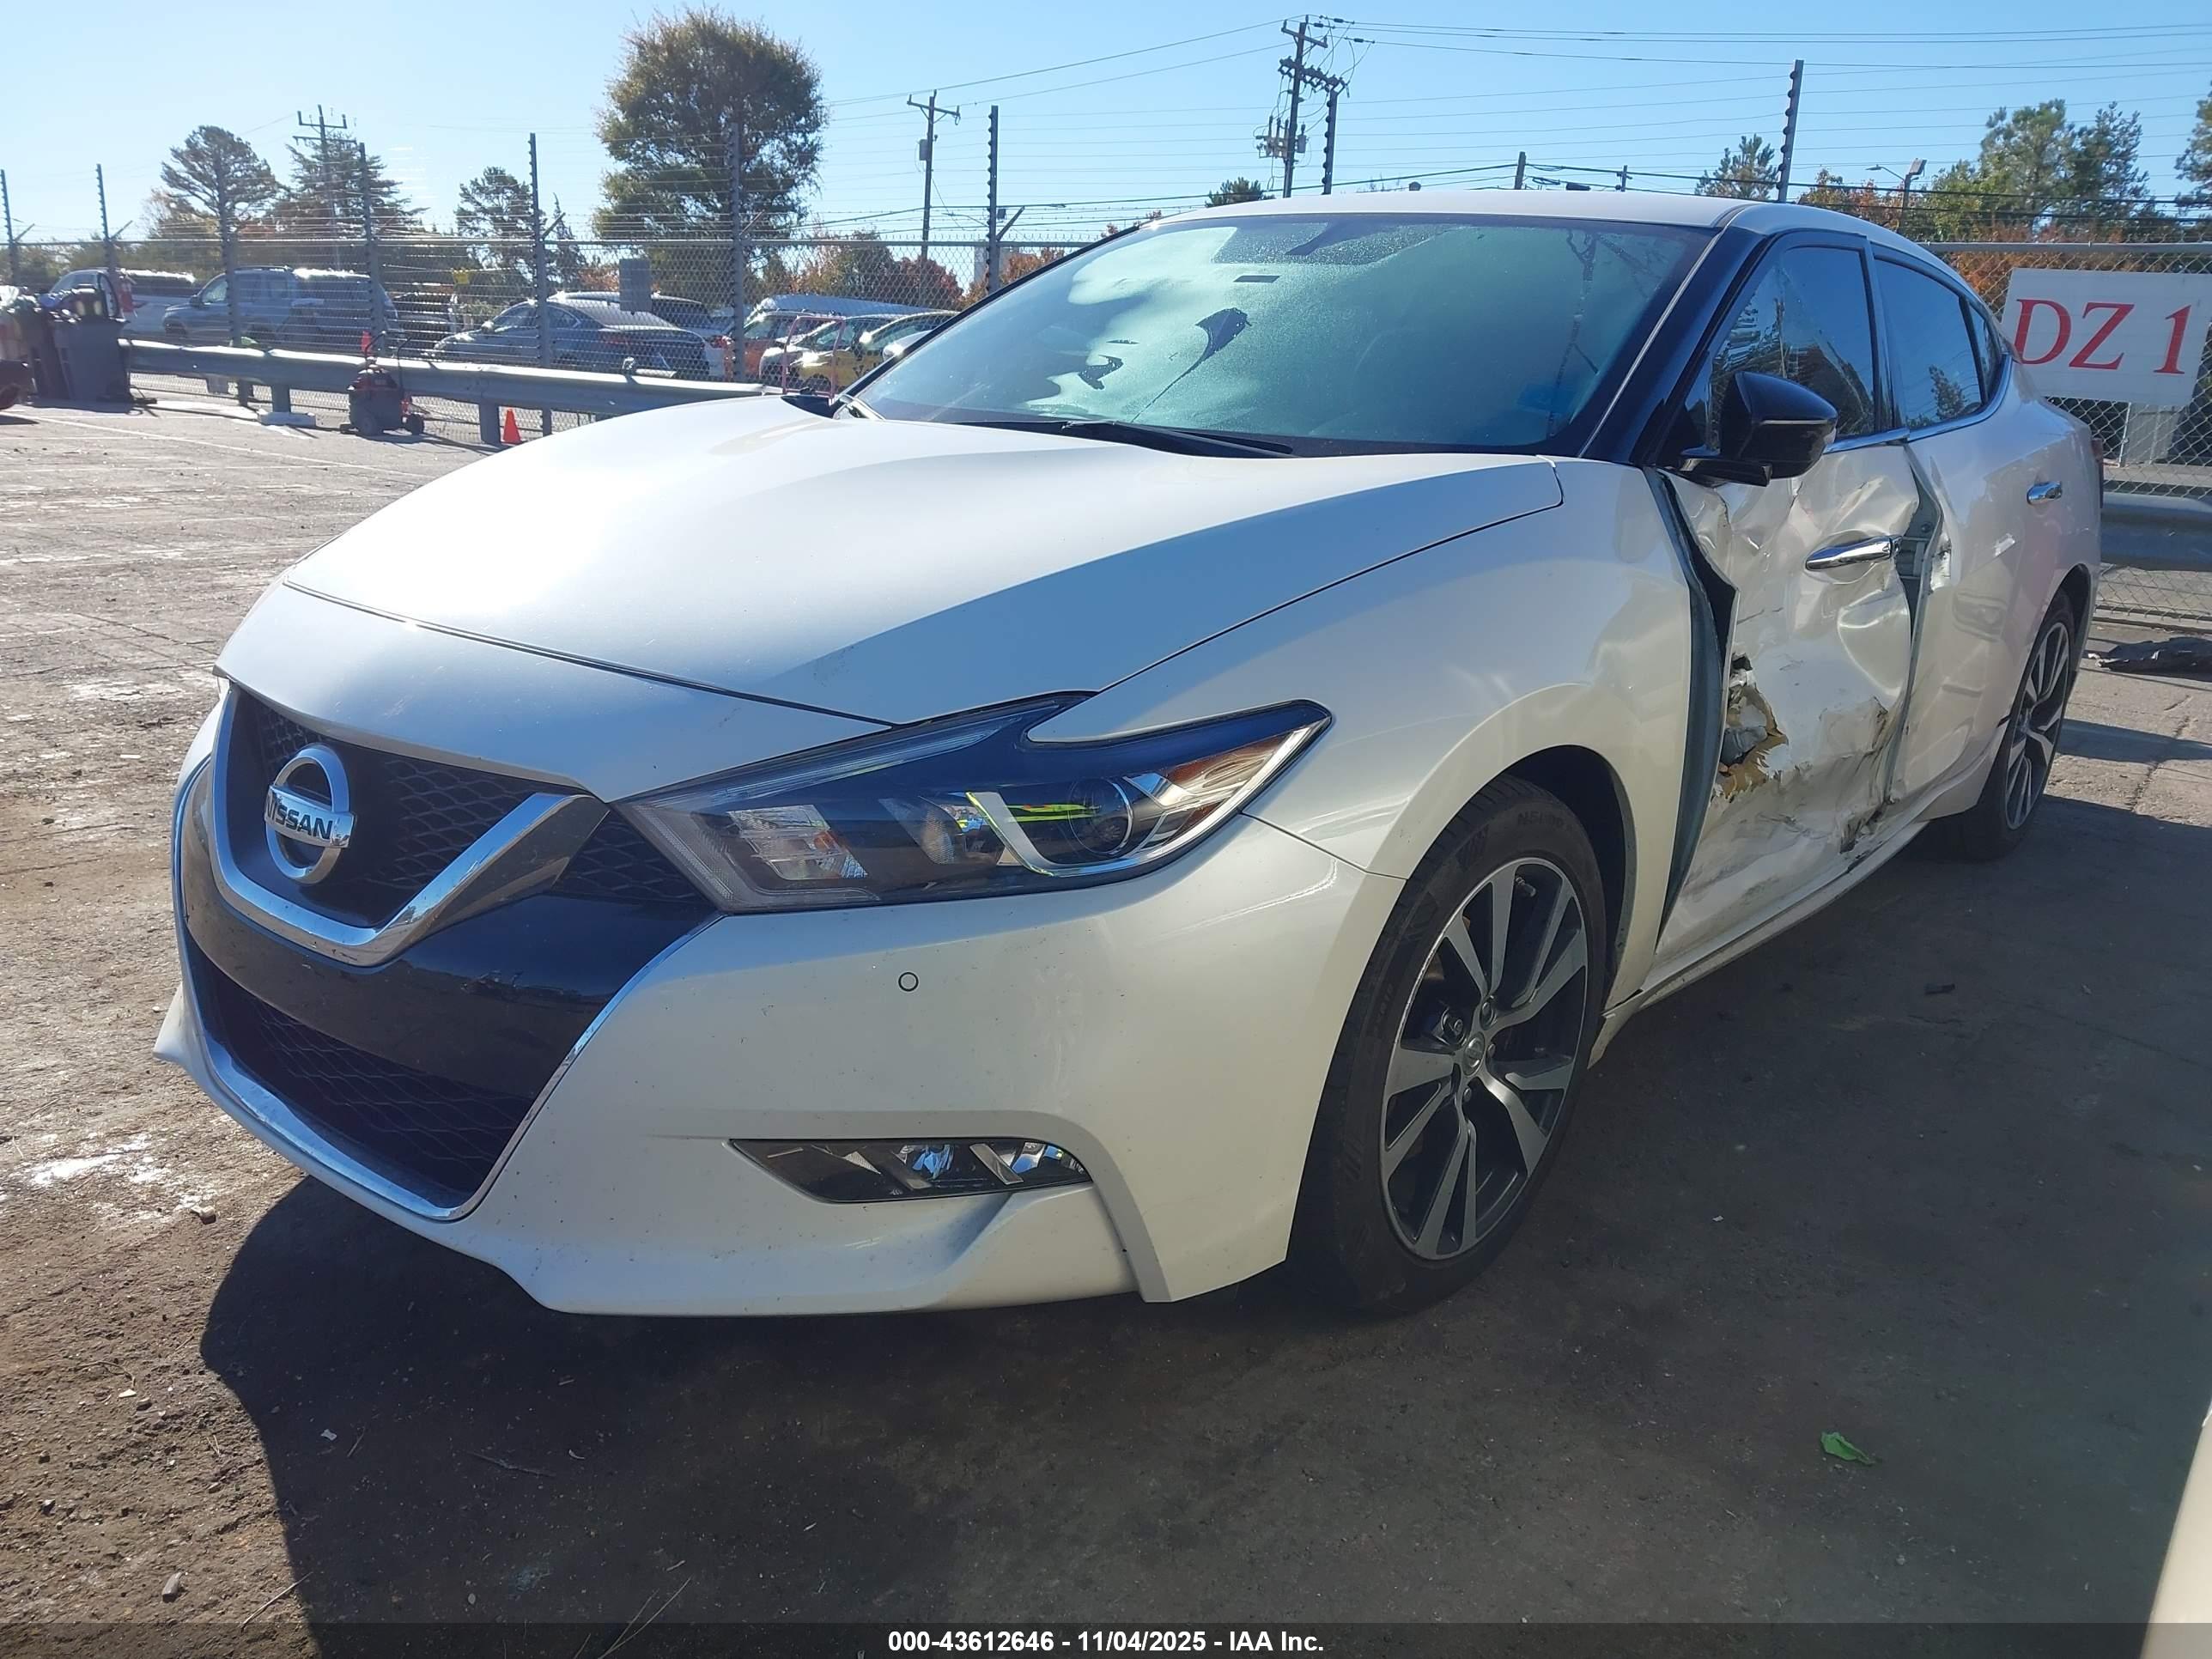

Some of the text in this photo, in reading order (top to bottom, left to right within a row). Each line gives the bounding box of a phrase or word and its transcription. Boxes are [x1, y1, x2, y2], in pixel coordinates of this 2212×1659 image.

[2014, 298, 2191, 374] DZ 1
[265, 791, 334, 841] NISSAN
